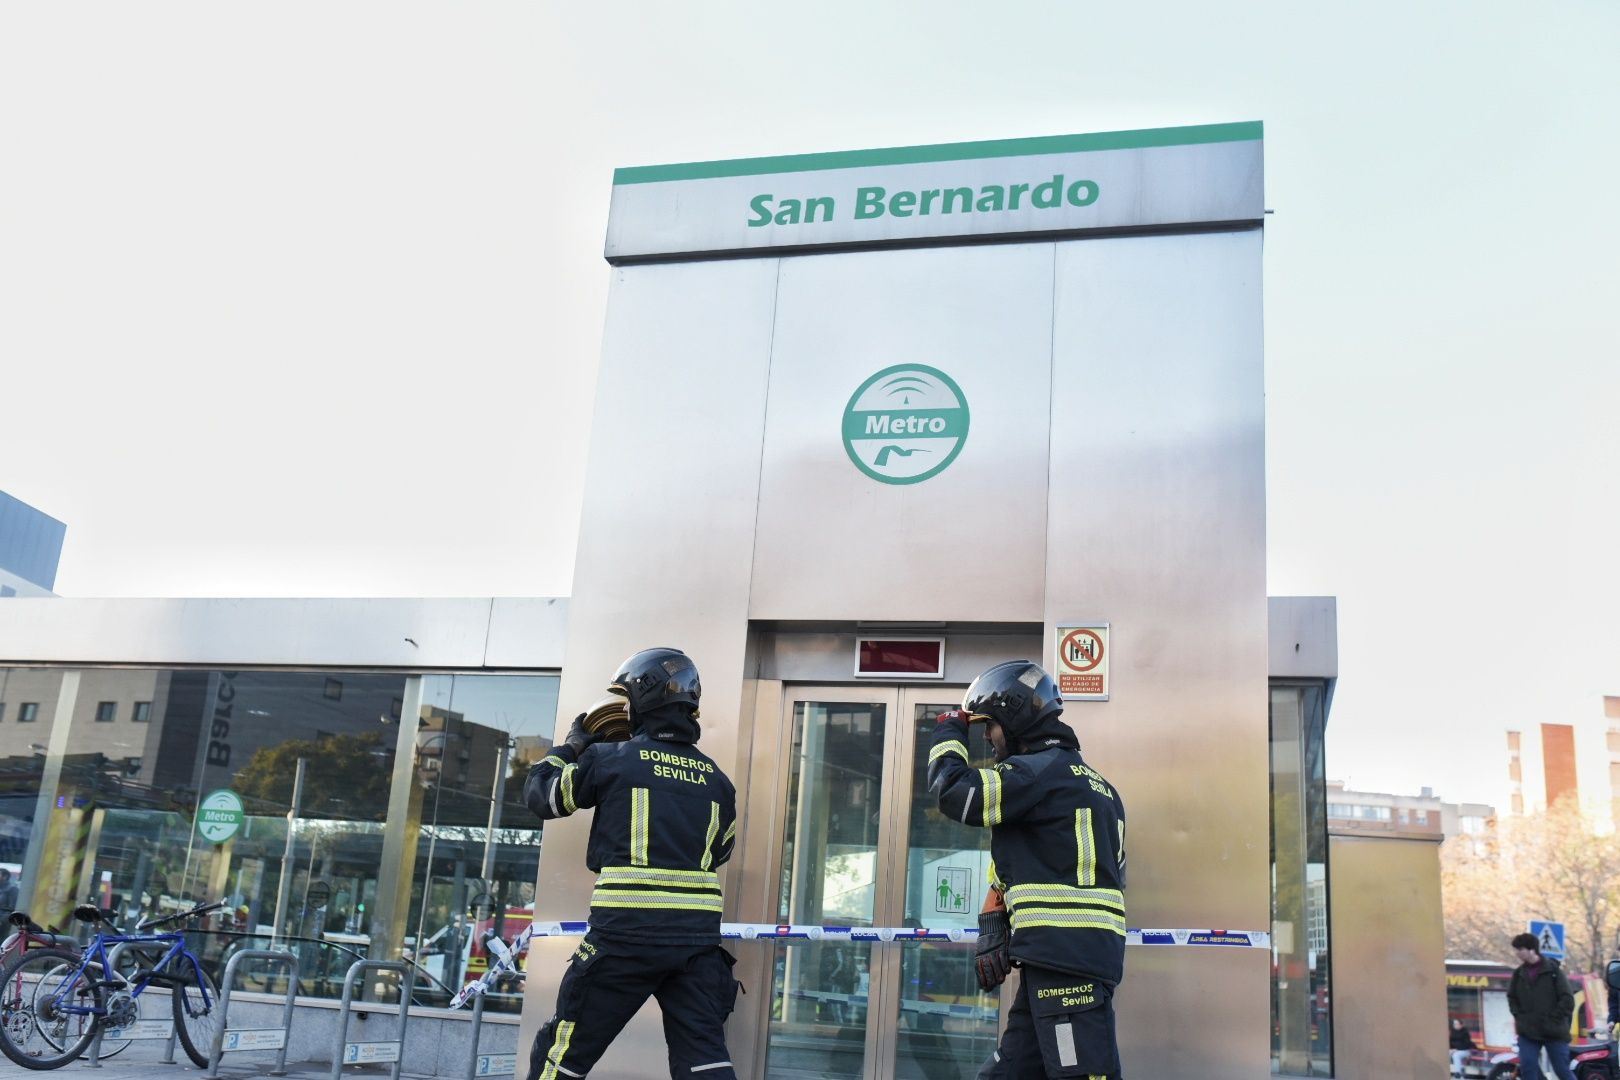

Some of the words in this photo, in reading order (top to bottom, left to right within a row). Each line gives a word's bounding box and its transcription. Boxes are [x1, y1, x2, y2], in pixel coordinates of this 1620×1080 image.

[748, 194, 835, 227] San
[854, 174, 1100, 220] Bernardo
[865, 415, 946, 434] Metro
[640, 750, 714, 773] BOMBEROS
[653, 764, 707, 785] SEVILLA
[205, 811, 236, 822] Metro
[1037, 983, 1094, 998] BOMBEROS
[1062, 995, 1094, 1006] Sevilla
